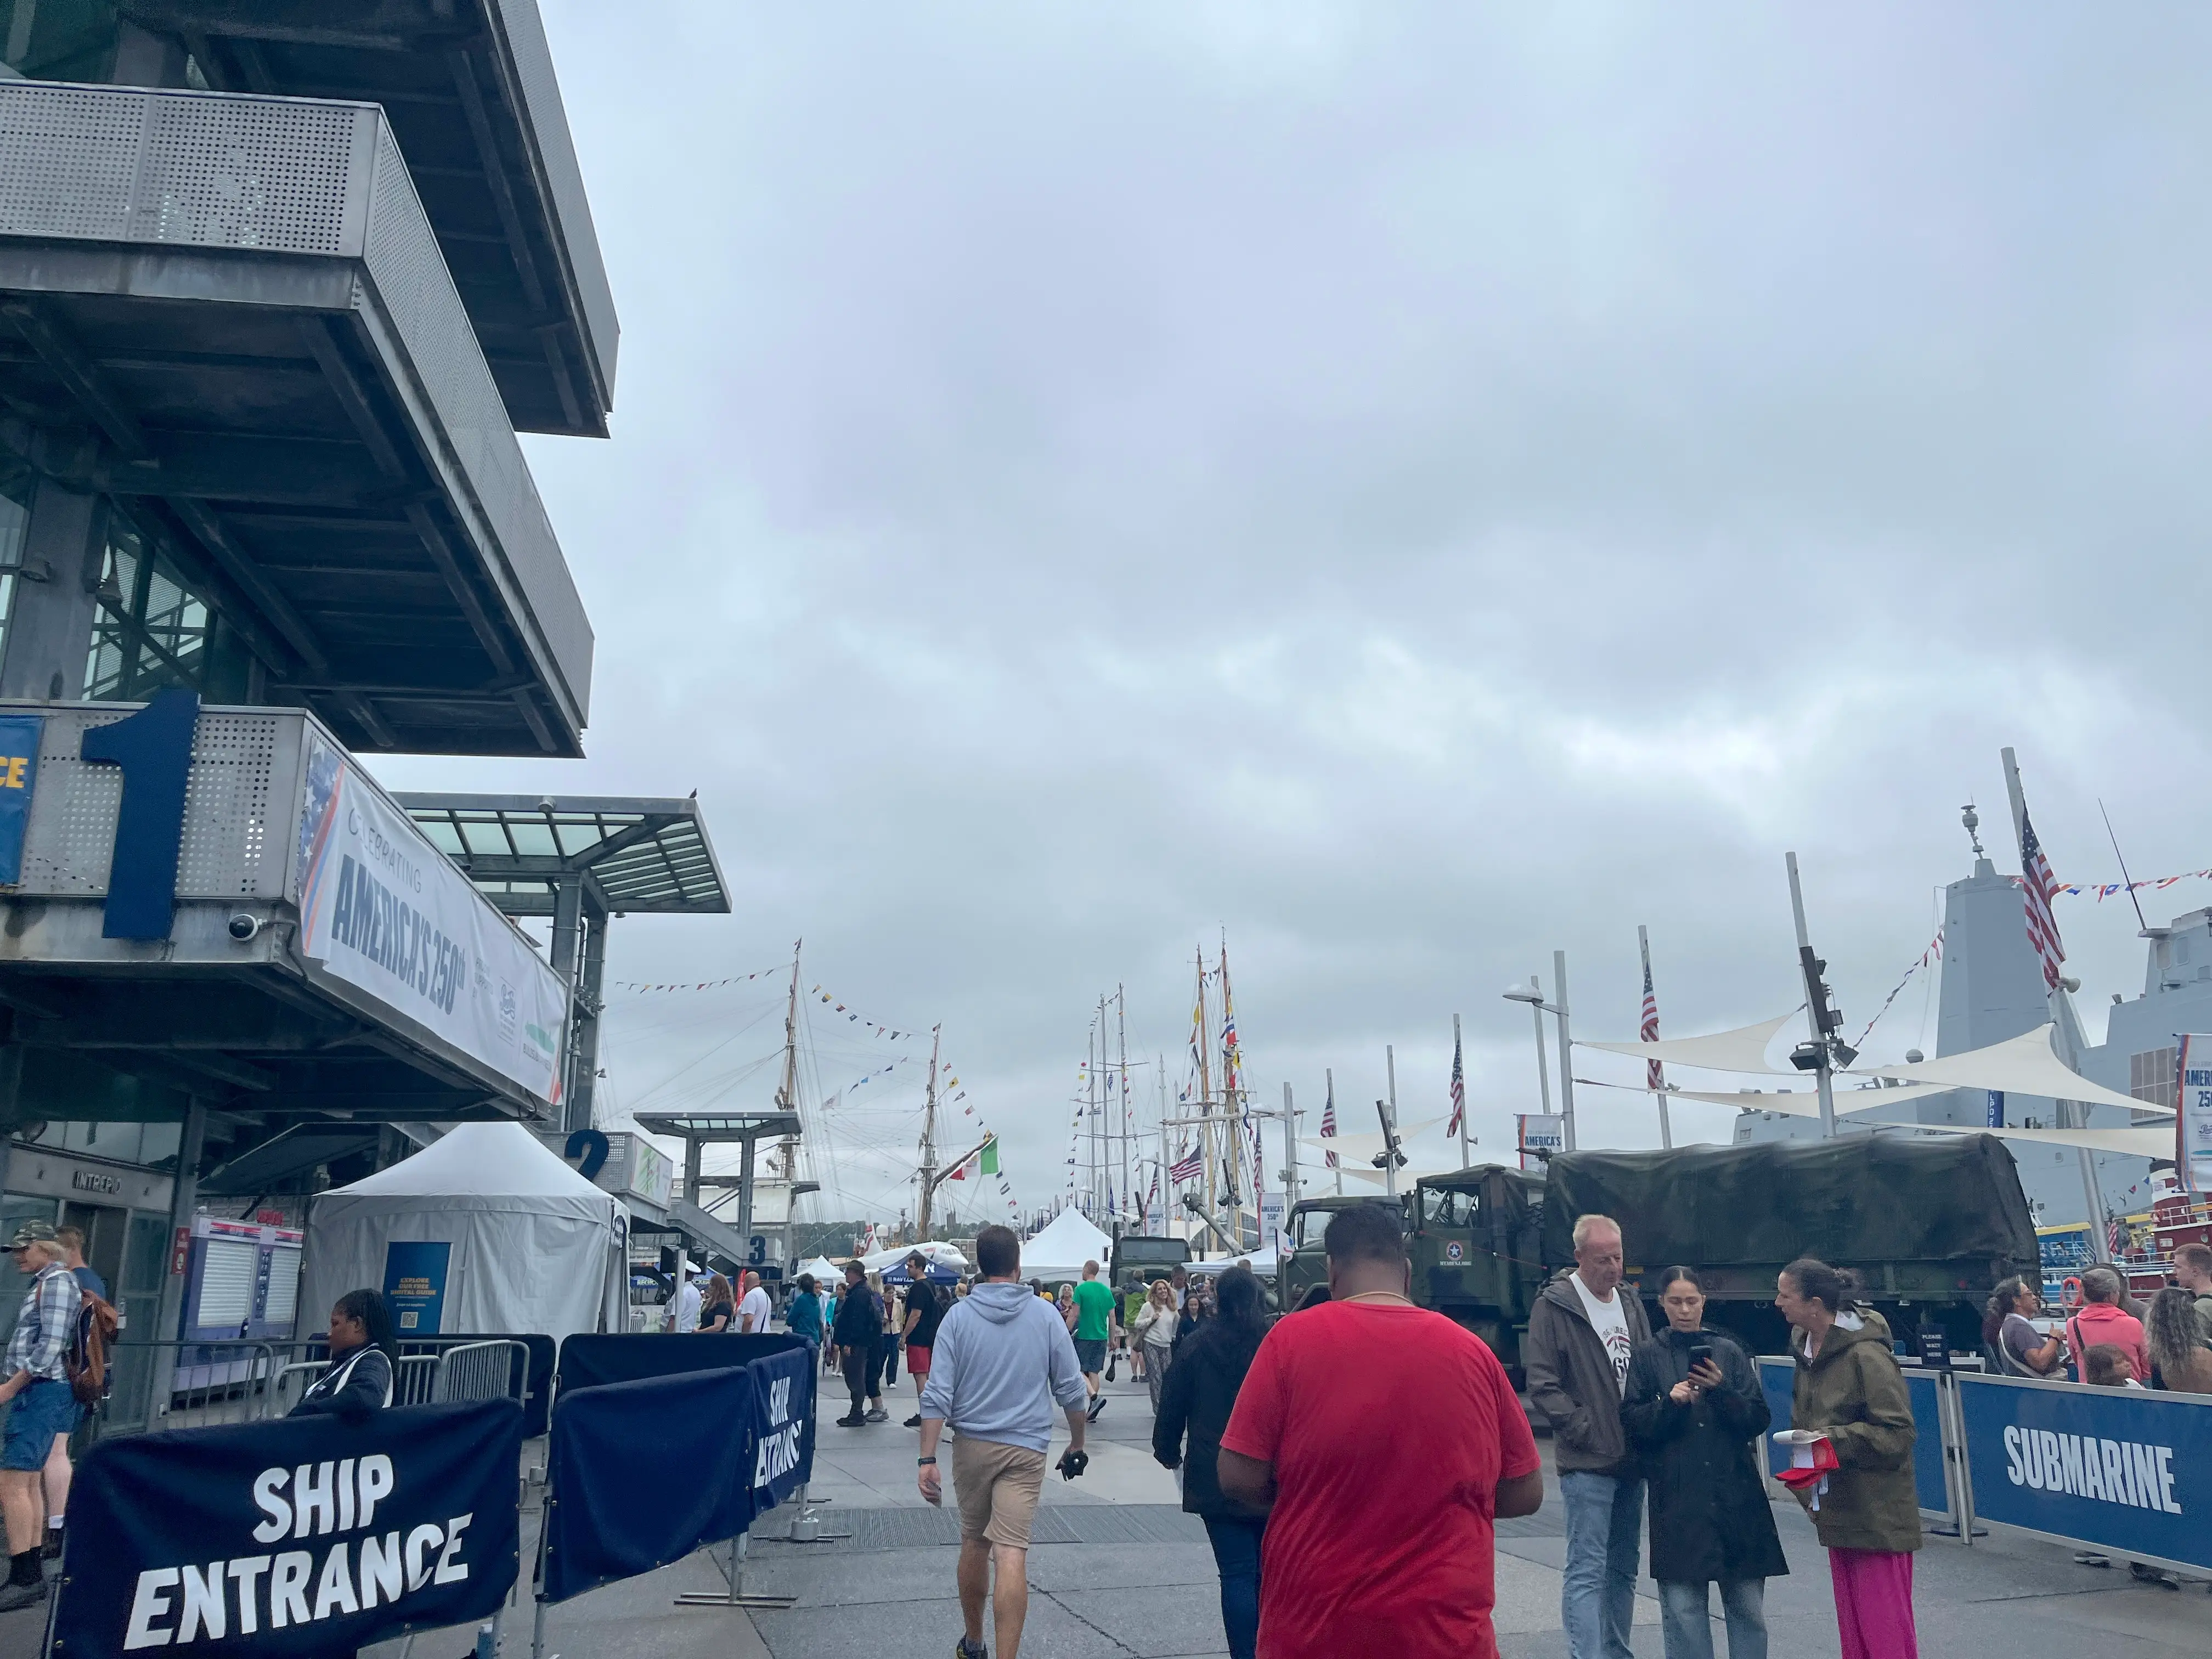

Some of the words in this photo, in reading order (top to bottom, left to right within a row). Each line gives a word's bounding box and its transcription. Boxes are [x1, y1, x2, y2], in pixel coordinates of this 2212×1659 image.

[81, 689, 199, 938] 1
[332, 853, 432, 997] AMERICA'S
[429, 929, 466, 1015] 250th
[564, 1129, 610, 1182] 2
[1525, 1136, 1561, 1147] AMERICA'S
[749, 1235, 766, 1265] 3
[770, 1376, 791, 1427] SHIP
[252, 1454, 394, 1543] SHIP
[2004, 1425, 2182, 1514] SUBMARINE
[123, 1513, 473, 1650] ENTRANCE
